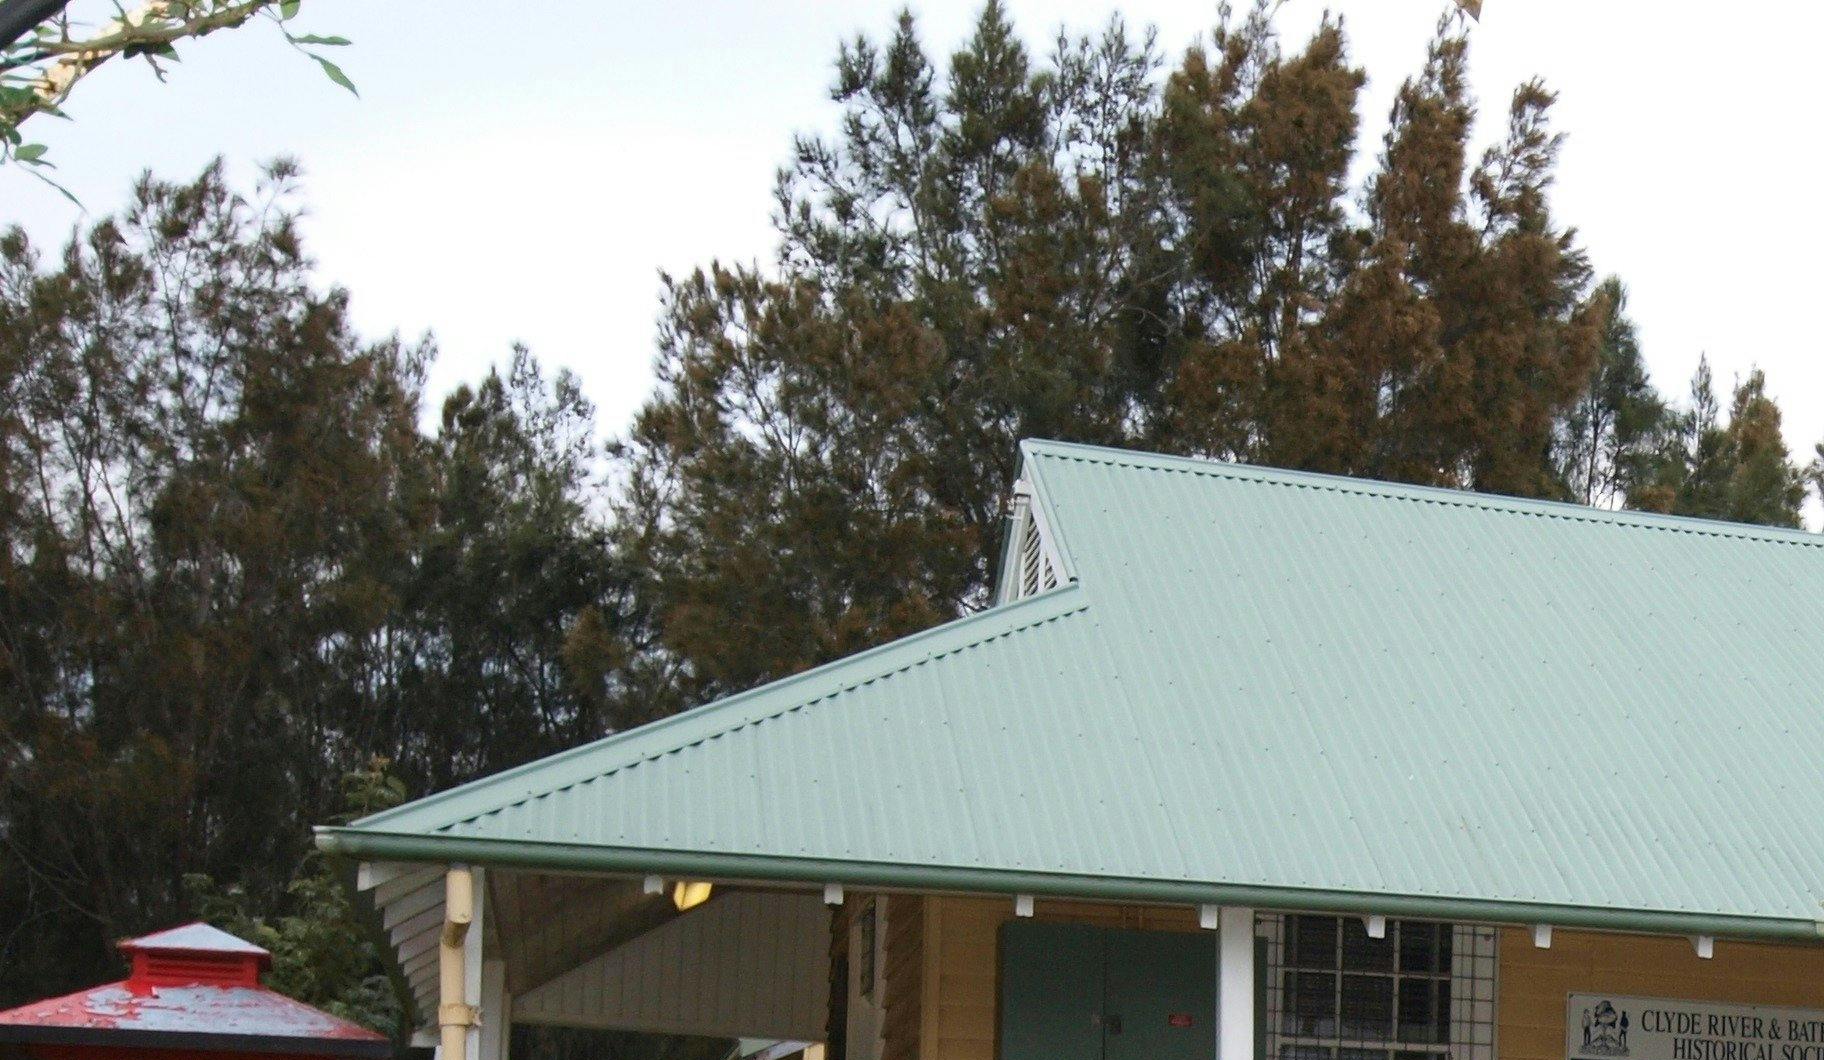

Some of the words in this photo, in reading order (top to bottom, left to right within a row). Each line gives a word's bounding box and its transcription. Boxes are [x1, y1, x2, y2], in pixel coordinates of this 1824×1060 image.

[1641, 1009, 1702, 1035] CLYDE
[1707, 1014, 1763, 1039] RIVER
[1768, 1018, 1782, 1040] &
